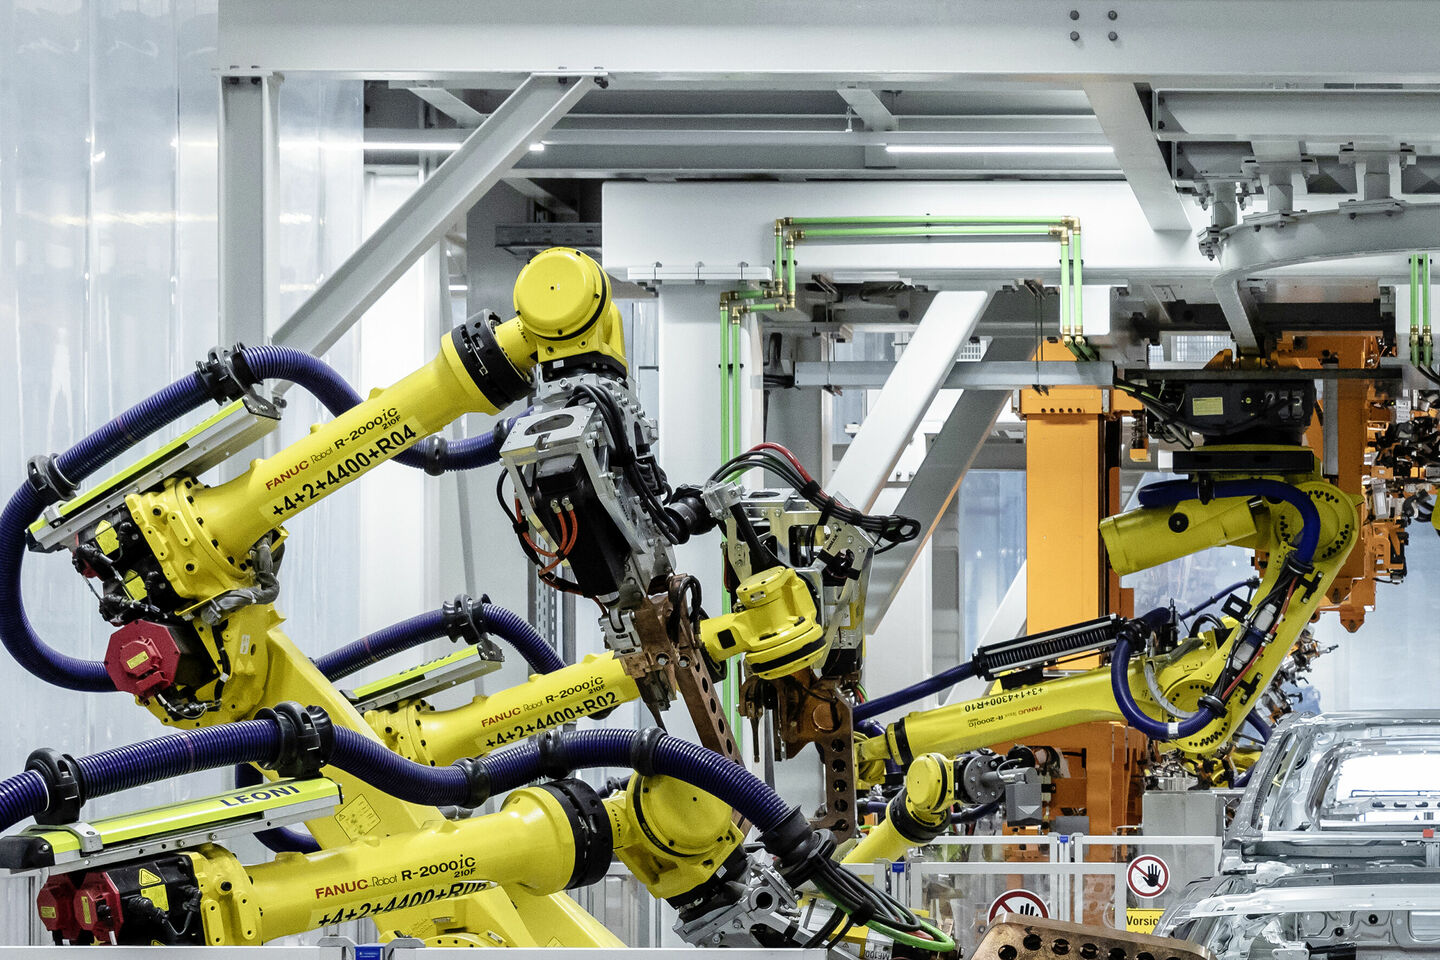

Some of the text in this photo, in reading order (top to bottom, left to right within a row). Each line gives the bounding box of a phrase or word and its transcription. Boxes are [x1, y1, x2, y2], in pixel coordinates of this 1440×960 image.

[382, 414, 401, 431] 210F
[265, 407, 399, 491] FANUC Robot R-2000iC
[272, 424, 417, 516] +4+2+4400+R04
[481, 676, 604, 728] FANUC Robot R-2000iC
[588, 684, 606, 695] 210F
[964, 687, 1044, 713] +3+1+4300+R10
[485, 691, 619, 748] +4+2+4400+R02
[220, 785, 300, 807] LEONI
[315, 854, 477, 900] FANUC Robot R-2000iC
[454, 867, 477, 879] 210F
[1126, 914, 1160, 926] Vorsic
